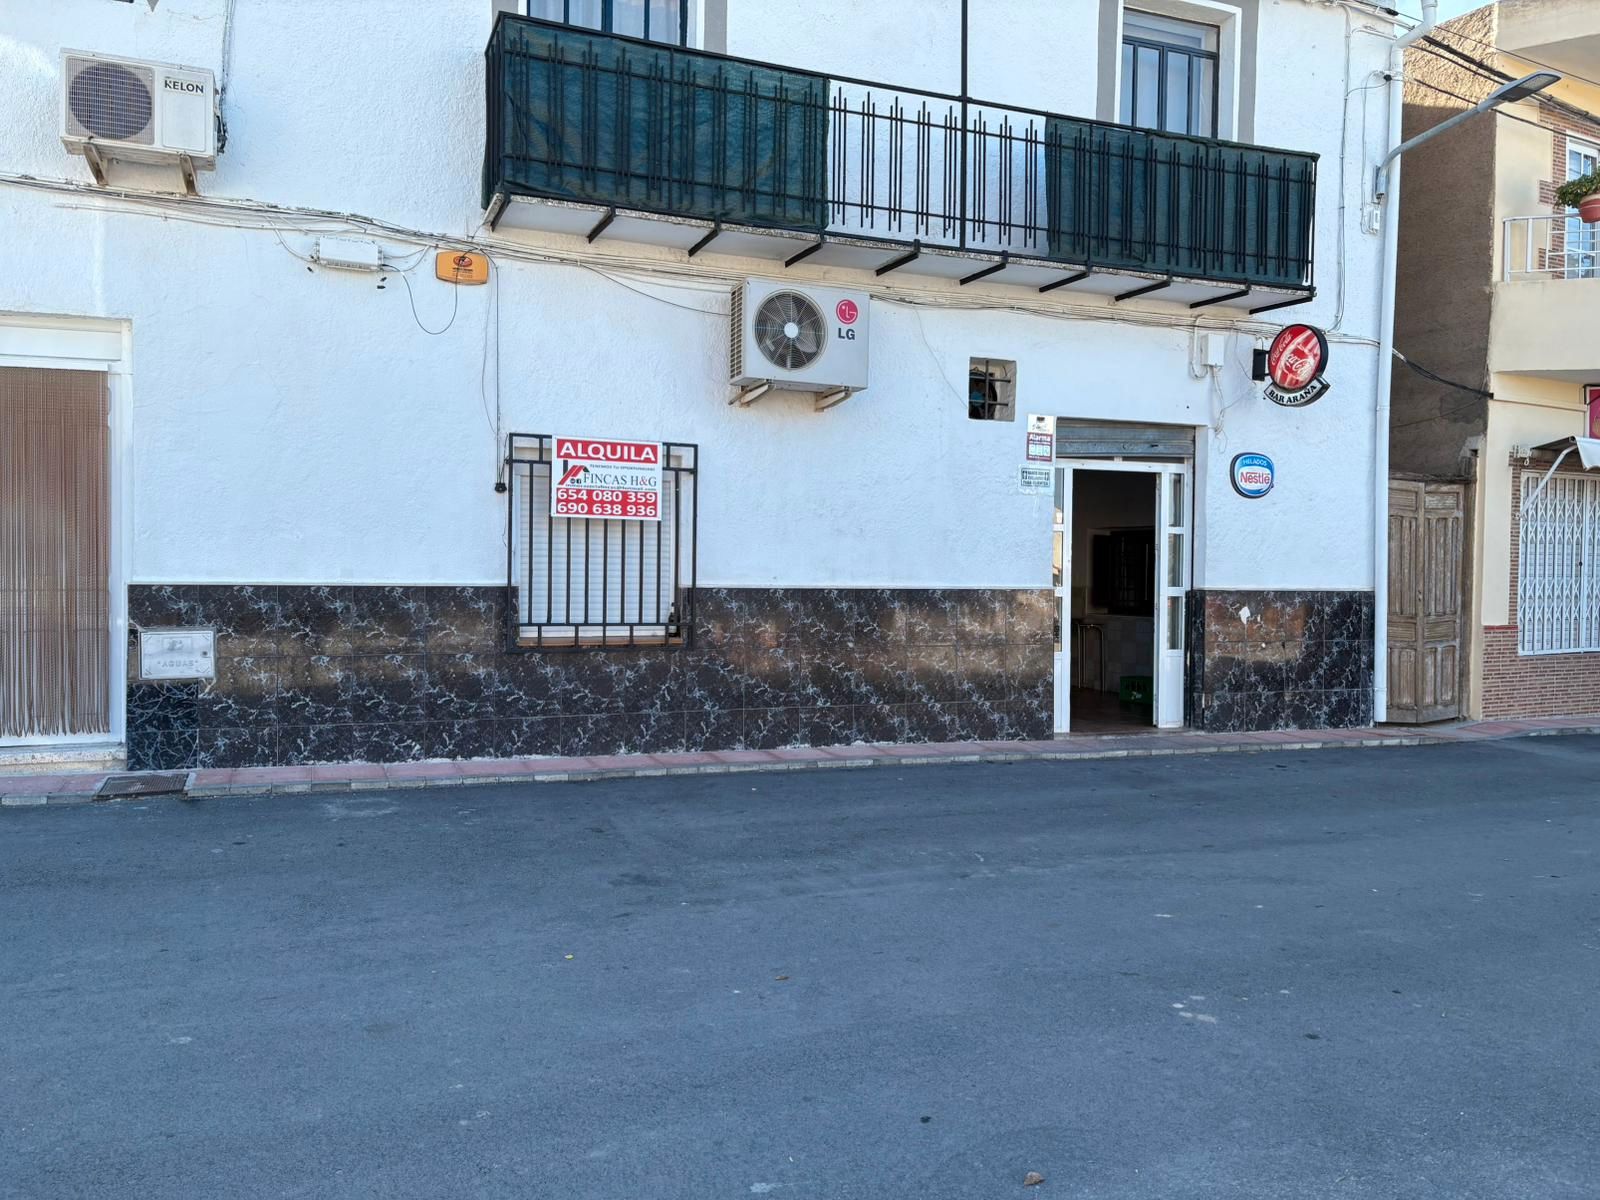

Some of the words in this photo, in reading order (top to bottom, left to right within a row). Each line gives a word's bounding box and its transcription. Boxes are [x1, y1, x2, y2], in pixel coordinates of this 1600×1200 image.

[164, 79, 204, 95] KELON
[838, 327, 856, 341] LG
[1268, 389, 1285, 403] BAR
[560, 442, 656, 461] ALQUILA
[1242, 457, 1268, 466] HELADOS
[583, 472, 627, 485] FINCAS
[630, 475, 657, 487] H&G
[557, 488, 588, 501] 654
[592, 490, 622, 502] 080
[626, 492, 656, 504] 359
[557, 502, 588, 514] 690
[592, 503, 622, 515] 638
[626, 504, 656, 516] 936
